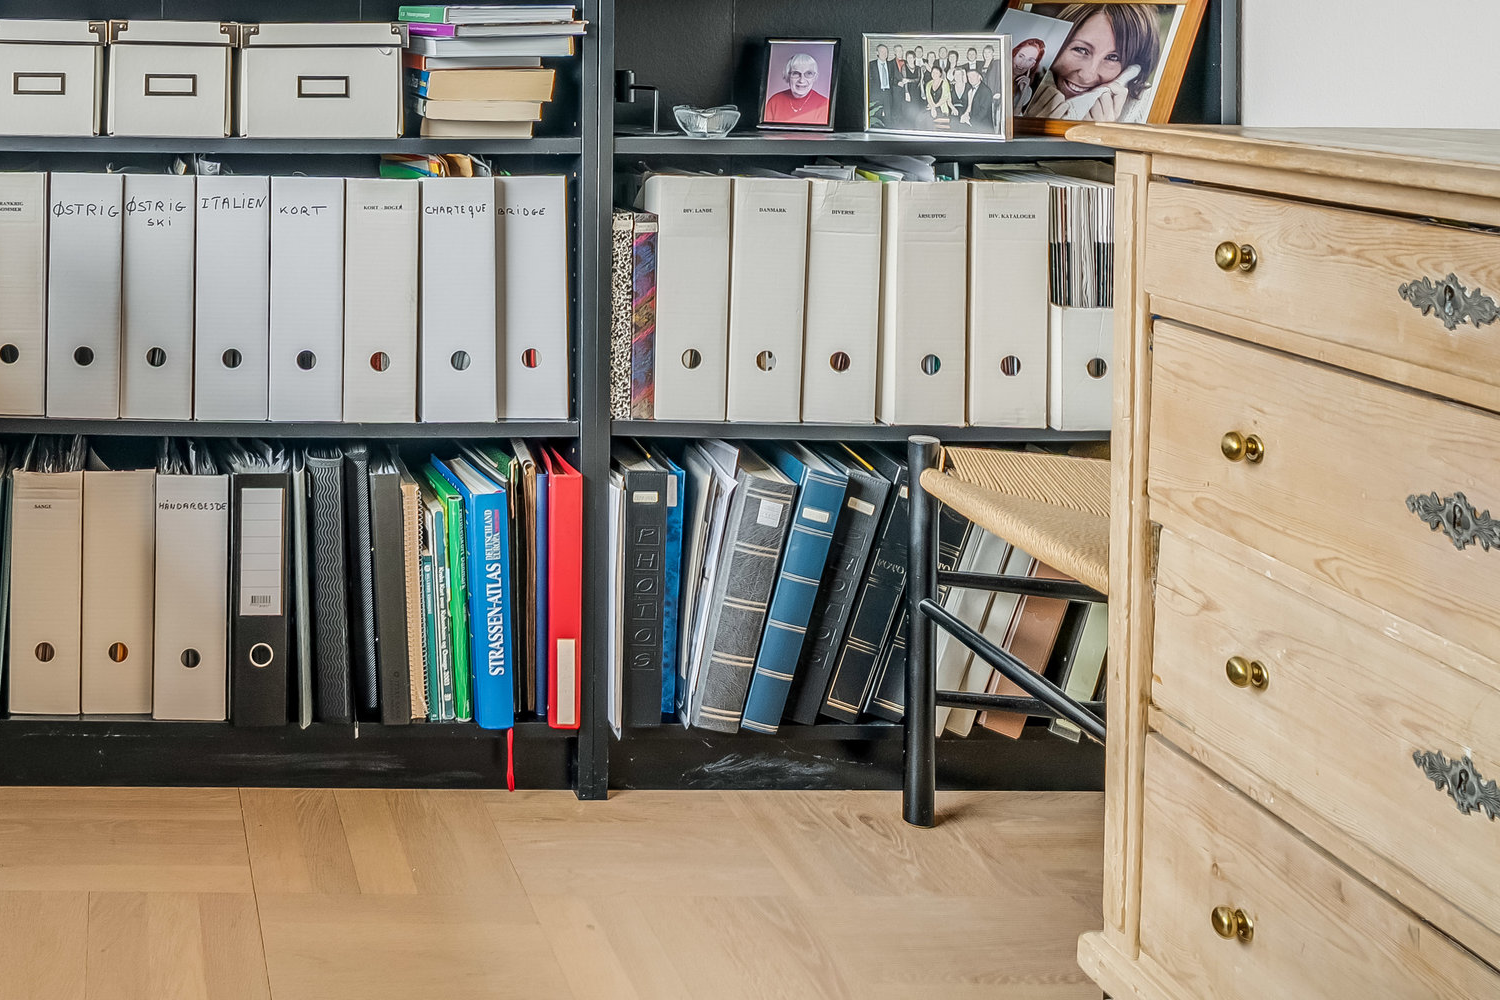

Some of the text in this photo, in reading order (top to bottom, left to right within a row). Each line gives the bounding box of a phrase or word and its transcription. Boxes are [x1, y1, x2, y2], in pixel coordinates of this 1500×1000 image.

[280, 205, 327, 216] KORT
[484, 509, 493, 560] DEUTSCHLAND
[492, 532, 500, 560] EUROPA
[488, 562, 504, 676] STRASSEN-ATLAS
